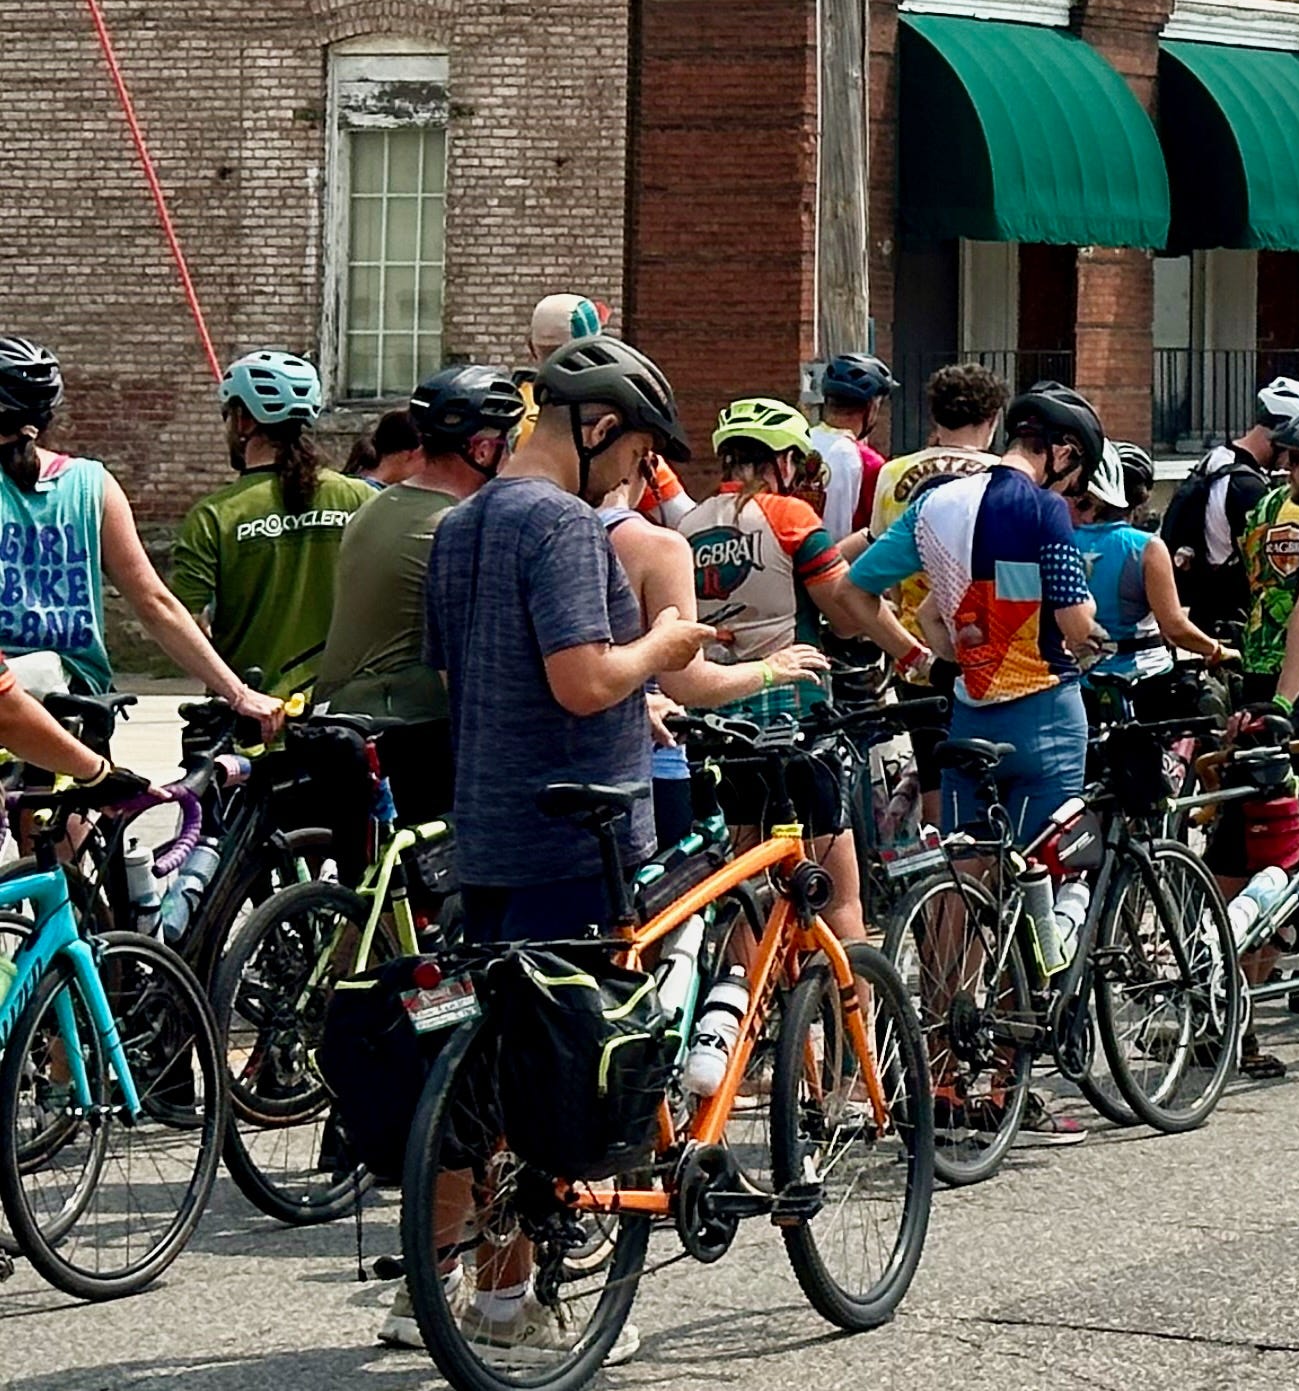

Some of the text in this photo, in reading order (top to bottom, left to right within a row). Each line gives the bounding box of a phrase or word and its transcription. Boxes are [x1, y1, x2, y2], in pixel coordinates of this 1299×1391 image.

[1, 522, 88, 566] GIRL
[696, 530, 765, 571] GBRAI
[1, 566, 91, 607] BIKE
[0, 609, 94, 649] GANG
